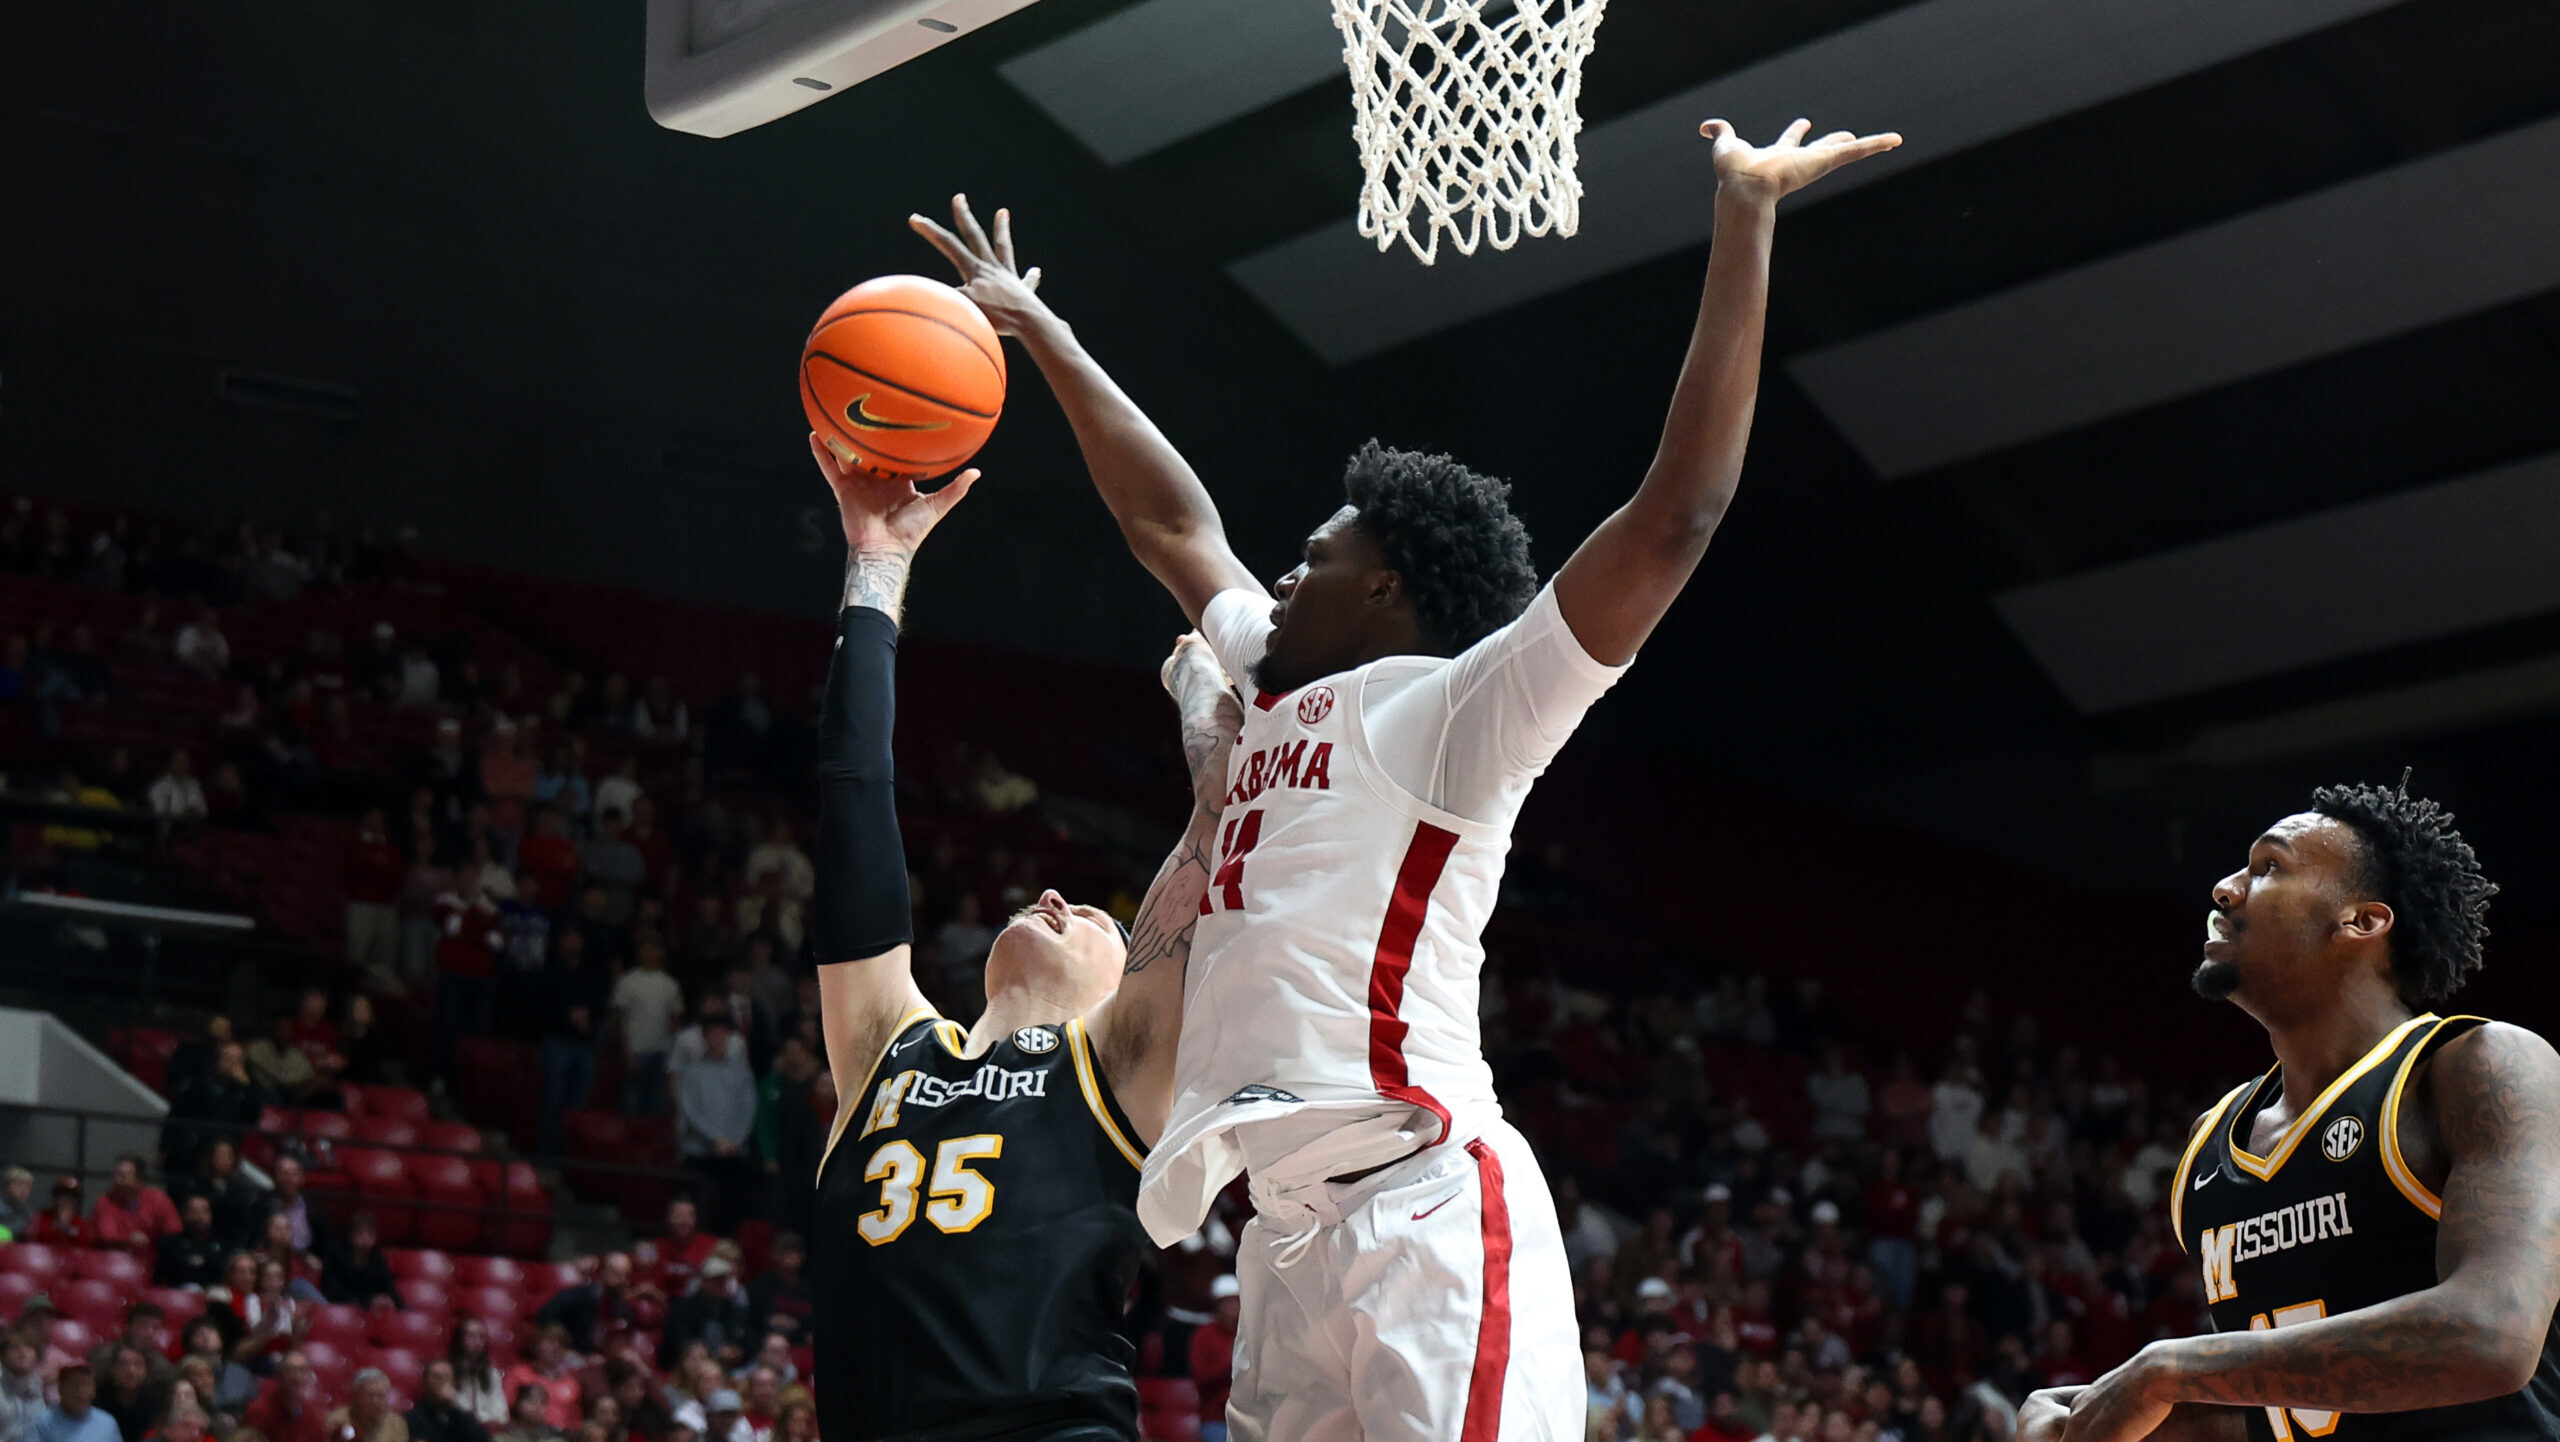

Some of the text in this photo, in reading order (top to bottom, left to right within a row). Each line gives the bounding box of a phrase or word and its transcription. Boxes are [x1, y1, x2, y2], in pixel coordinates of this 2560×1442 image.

[1299, 688, 1334, 723] SEC
[1015, 1026, 1057, 1052] SEC
[2325, 1118, 2361, 1159] SEC
[857, 1134, 1004, 1247] 35
[2201, 1192, 2353, 1305] MISSOURI
